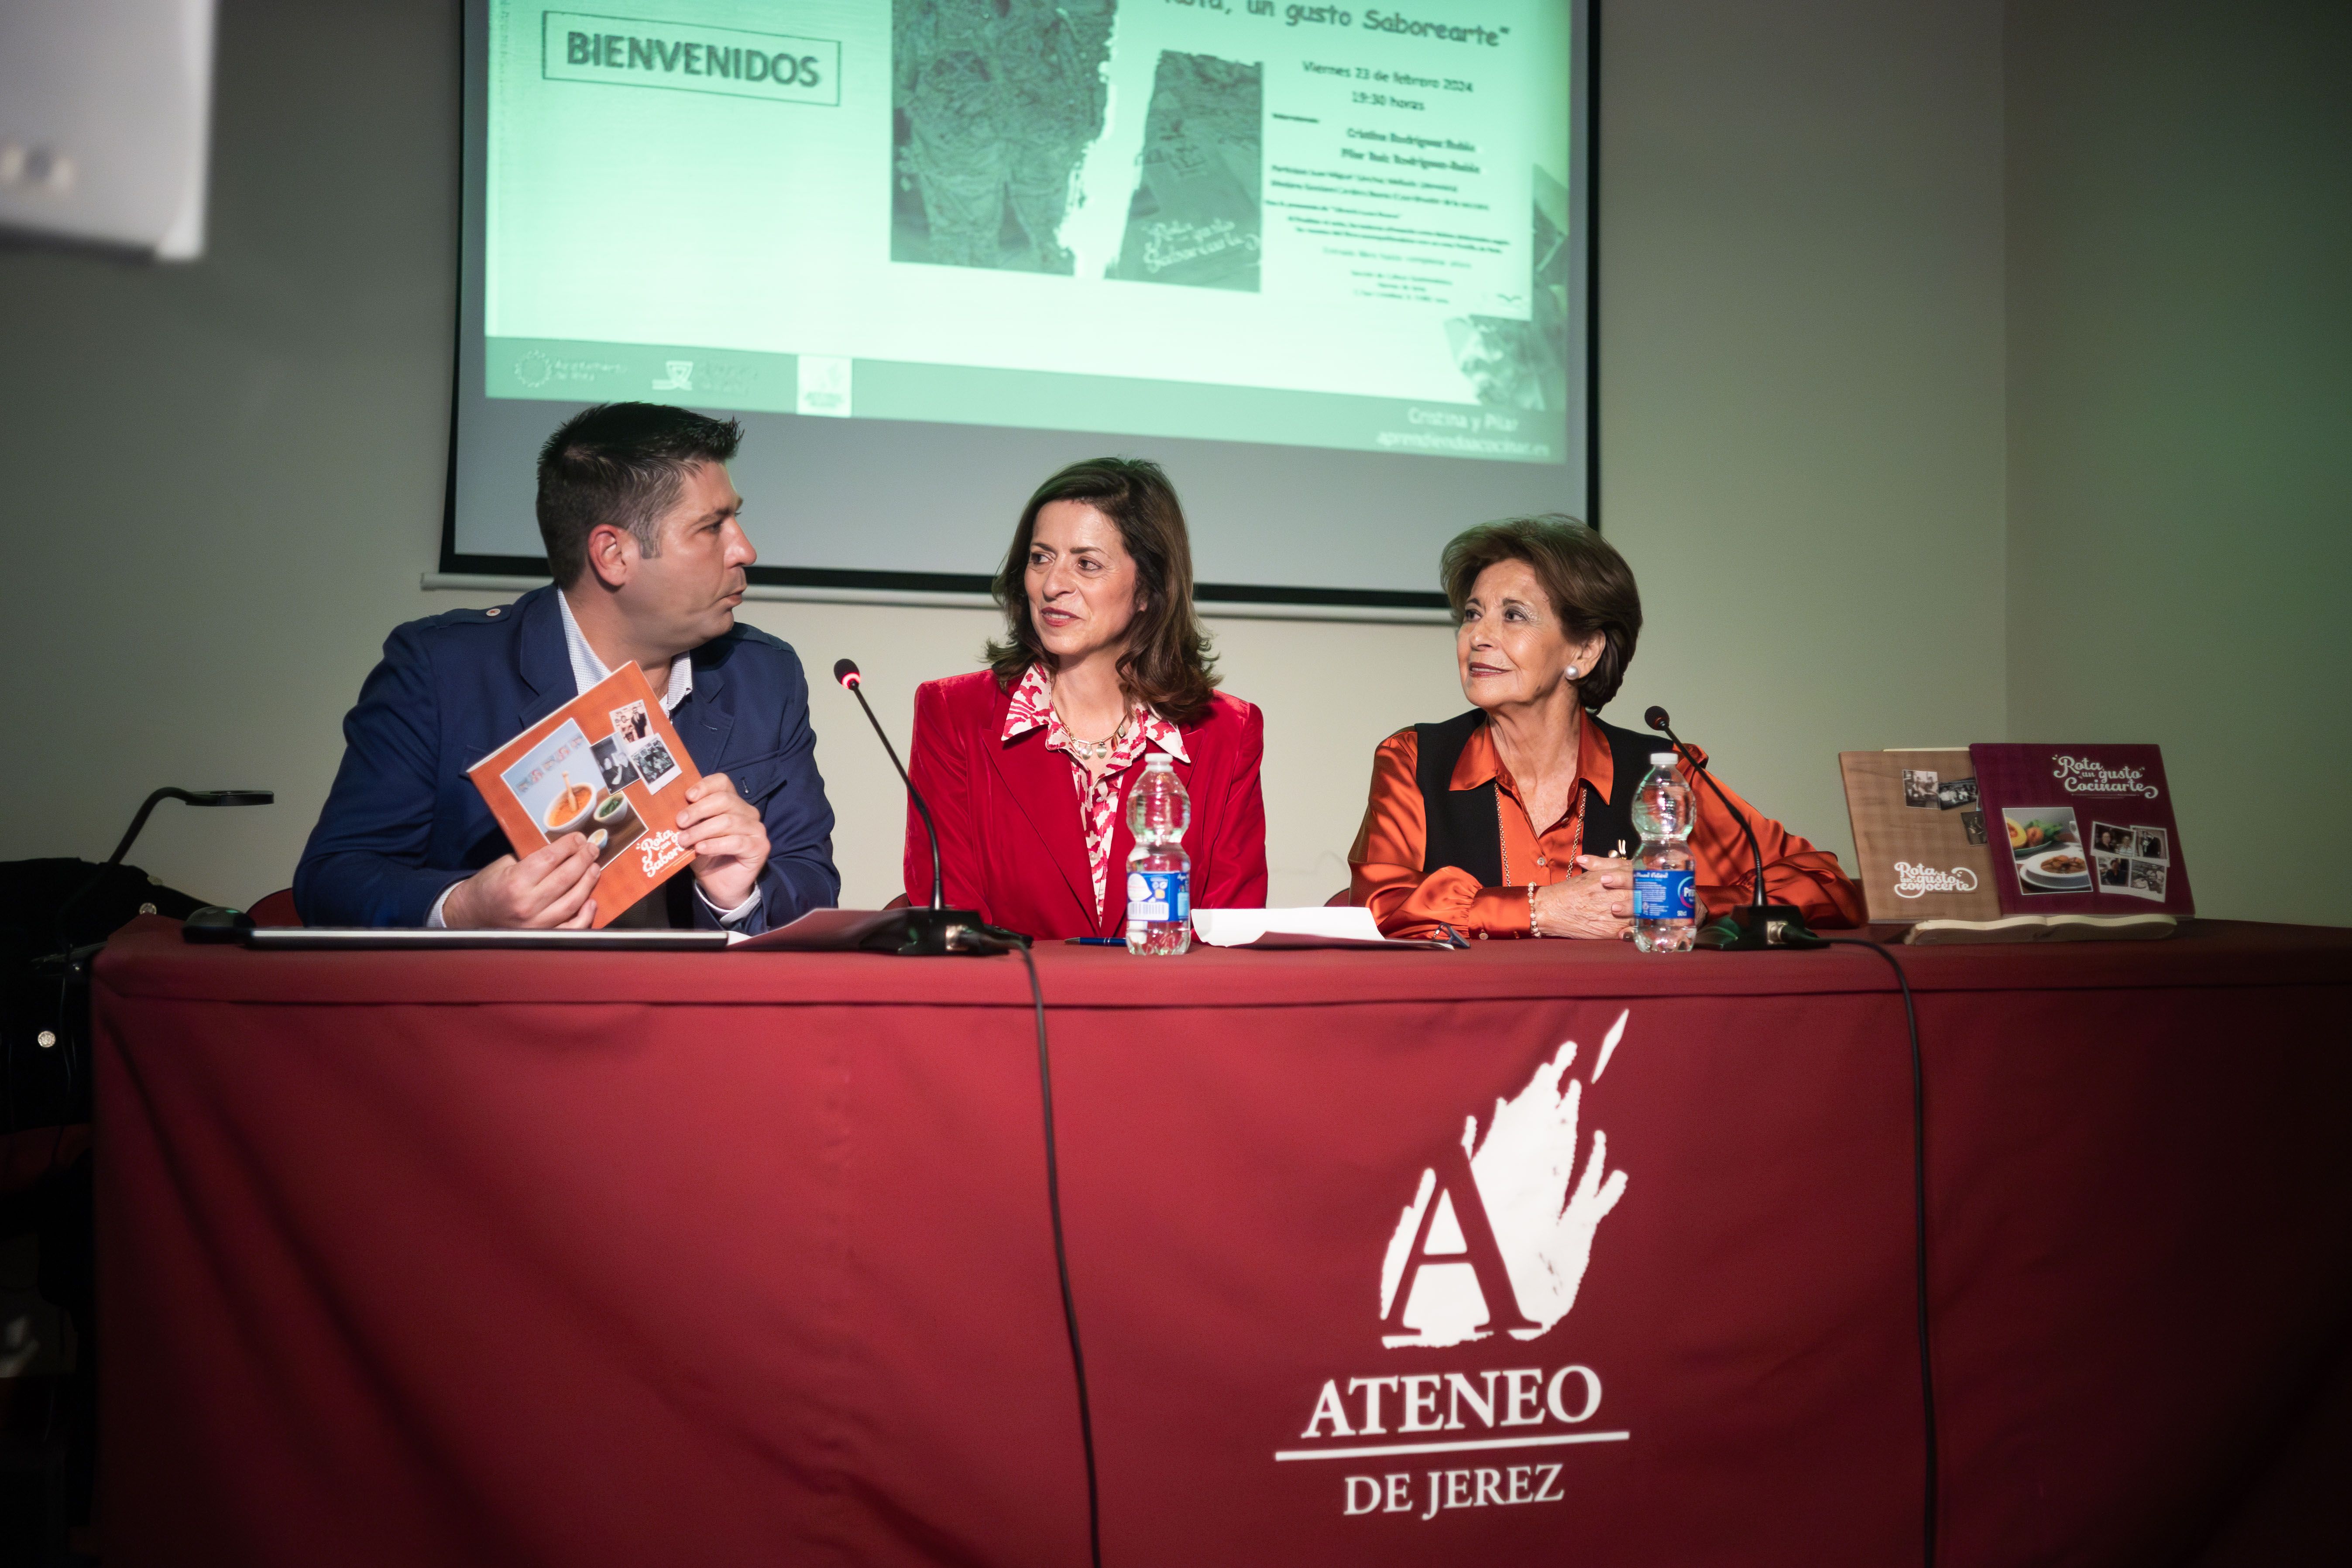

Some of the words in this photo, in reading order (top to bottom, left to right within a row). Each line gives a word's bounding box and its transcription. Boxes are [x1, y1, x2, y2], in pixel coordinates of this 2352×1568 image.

[1285, 4, 1351, 26] gusto
[567, 31, 820, 88] BIENVENIDOS
[1302, 61, 1351, 77] Viernes
[1355, 67, 1370, 79] 23
[1373, 71, 1389, 82] de
[1393, 72, 1439, 88] febrero
[1443, 78, 1473, 92] 2024
[1353, 91, 1386, 106] 19:30
[1390, 96, 1425, 110] horas
[1408, 407, 1468, 428] Cristina
[1470, 417, 1482, 433] y
[1485, 413, 1518, 432] Pilar
[2098, 766, 2143, 783] gusto
[2065, 777, 2158, 799] Cocinarte
[1894, 862, 1937, 878] Rota
[1916, 871, 1957, 886] gusto
[1301, 1365, 1602, 1438] ATENEO
[1344, 1473, 1413, 1516] DE
[1422, 1464, 1564, 1520] JEREZ
